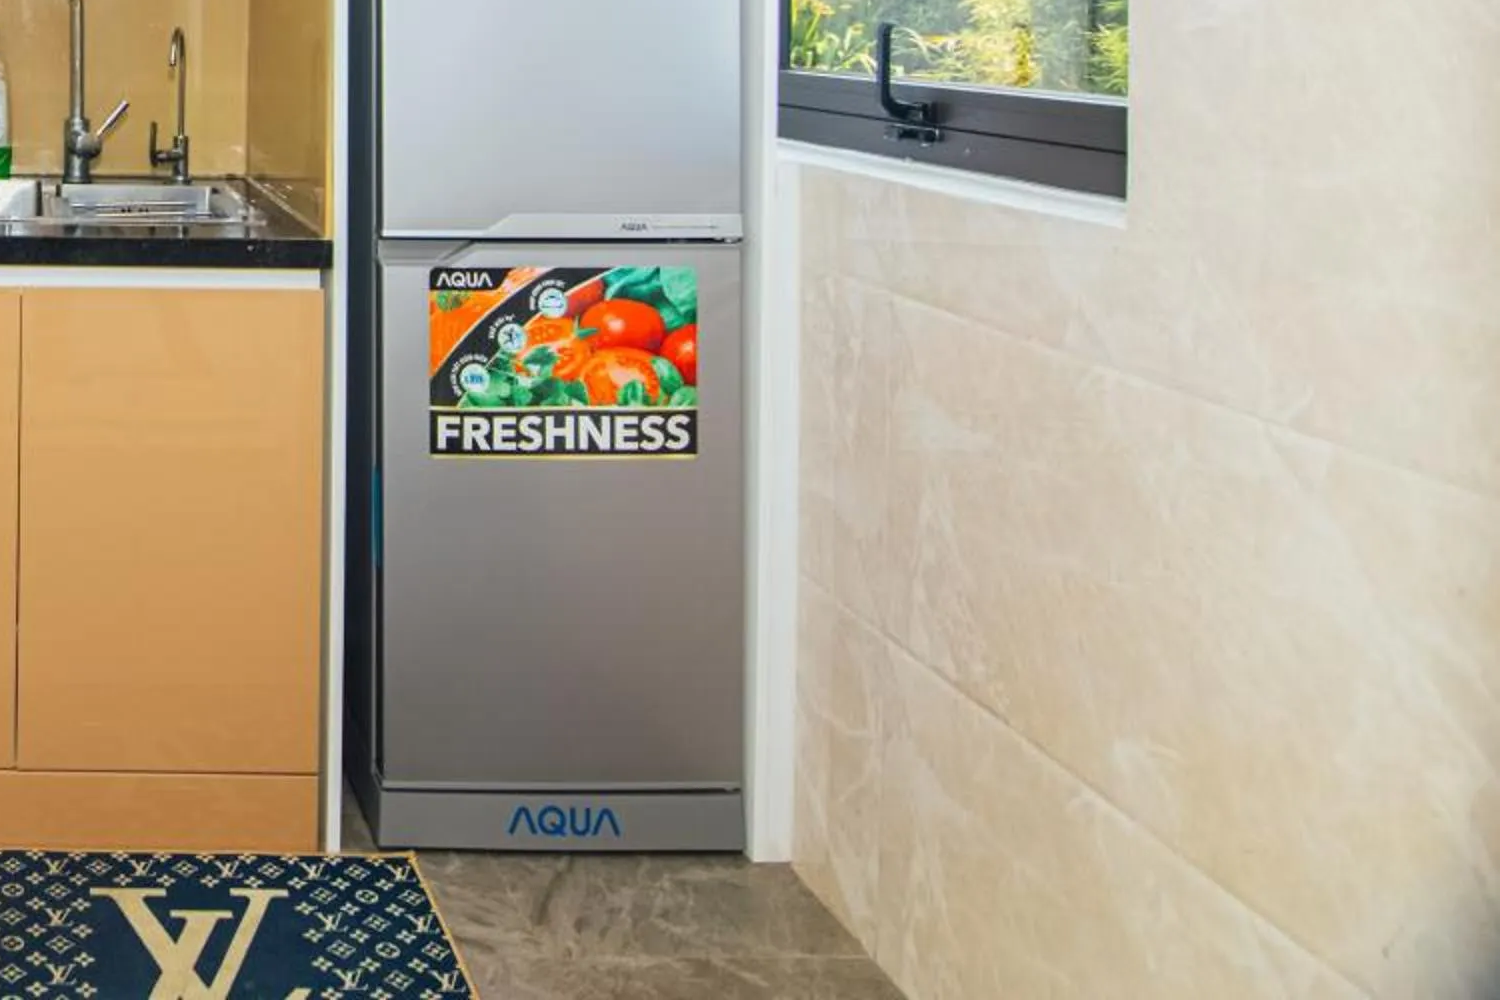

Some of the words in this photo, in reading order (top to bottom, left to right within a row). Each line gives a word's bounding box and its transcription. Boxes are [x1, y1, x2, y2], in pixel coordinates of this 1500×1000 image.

[436, 271, 493, 288] AQUA
[436, 415, 691, 451] FRESHNESS
[508, 805, 621, 837] AQUA
